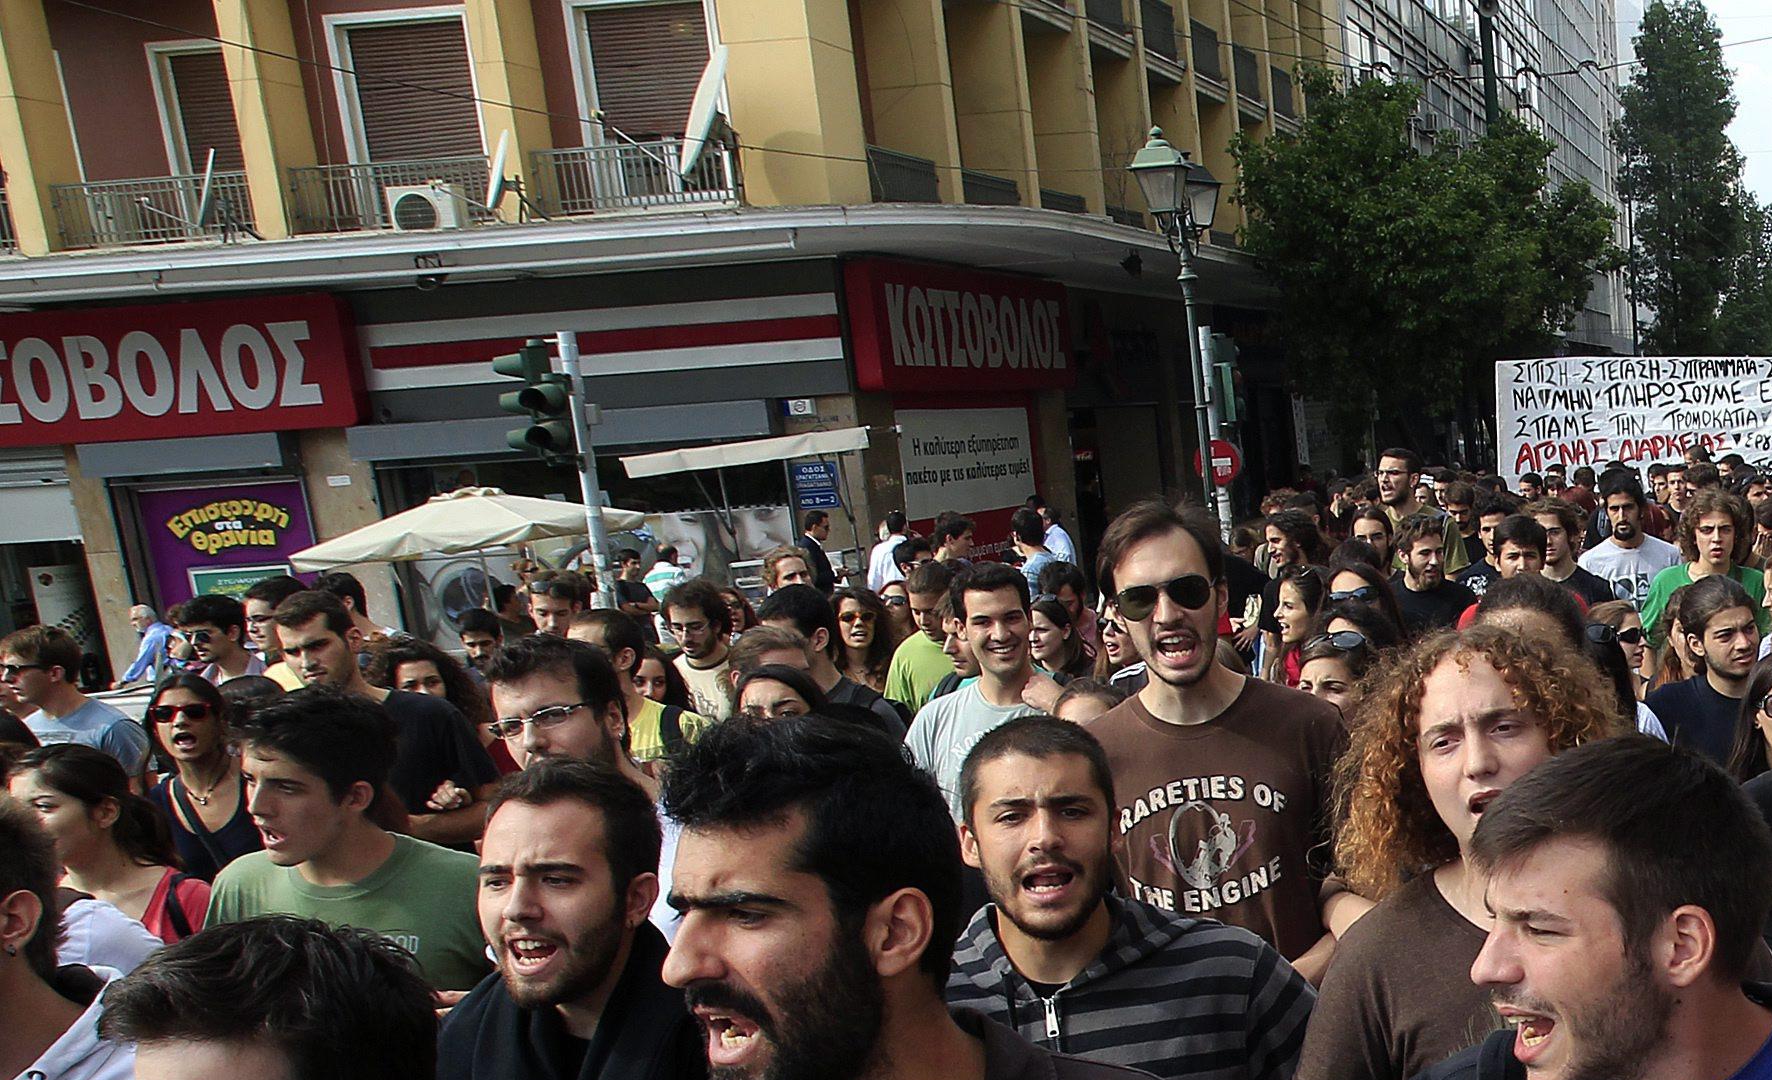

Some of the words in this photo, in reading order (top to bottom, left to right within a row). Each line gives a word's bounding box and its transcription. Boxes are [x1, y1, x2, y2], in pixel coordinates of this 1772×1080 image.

[885, 283, 1066, 369] ΚΩΤΣΟΒΟΛΟΣ
[1514, 412, 1599, 440] ΣΠΑΜΕ
[1609, 413, 1646, 436] ΤΗΝ
[912, 437, 920, 456] Η
[923, 435, 966, 458] καλύτερη
[968, 434, 1019, 456] εξυπηρέτηση
[906, 466, 938, 485] πακέτο
[940, 468, 951, 486] με
[952, 467, 965, 481] τις
[966, 461, 1007, 481] καλύτερες
[214, 520, 243, 531] στα
[1119, 775, 1245, 835] RARETIES
[1253, 782, 1286, 813] OF
[1129, 876, 1175, 911] THE
[1183, 855, 1282, 912] ENGINE
